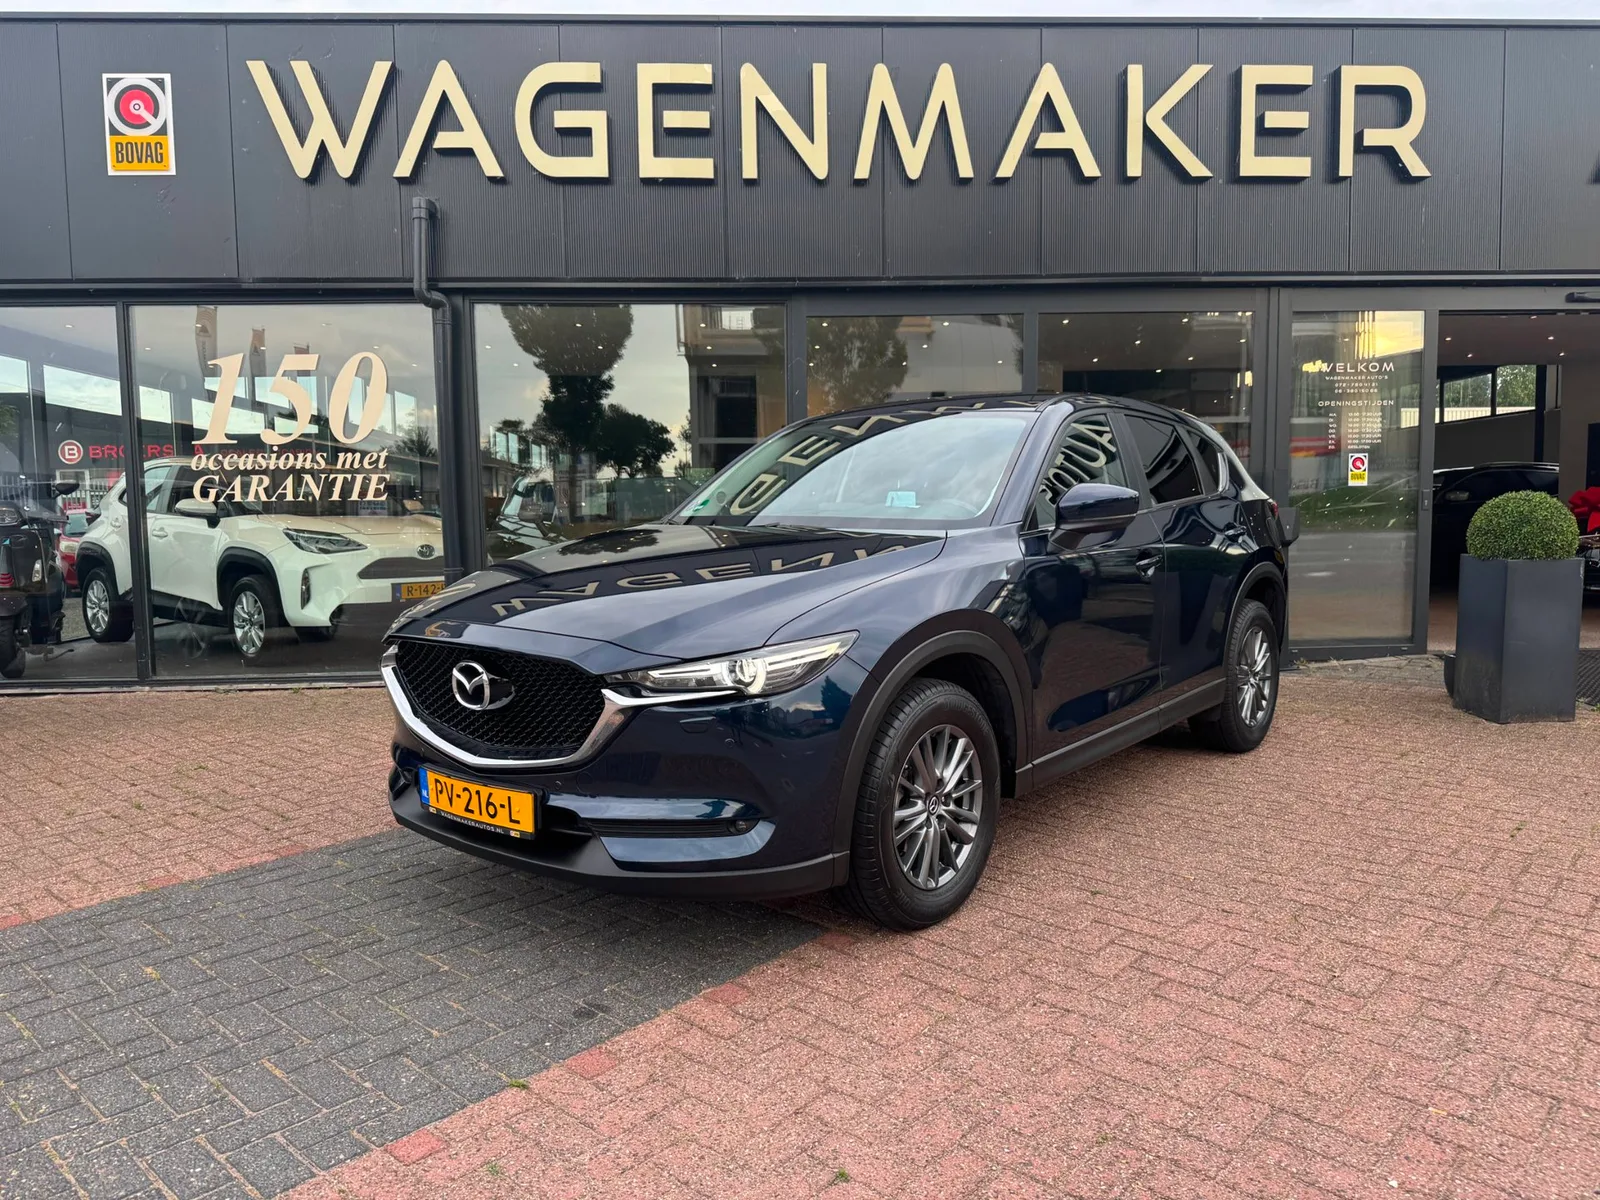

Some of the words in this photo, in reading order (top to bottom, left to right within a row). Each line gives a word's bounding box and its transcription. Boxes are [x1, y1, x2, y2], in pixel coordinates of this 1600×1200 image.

[246, 59, 1431, 182] WAGENMAKER
[115, 141, 164, 164] BOVAG
[191, 351, 389, 446] 150
[88, 445, 174, 459] BRRS
[190, 445, 327, 471] occasions
[336, 446, 388, 470] met
[192, 473, 391, 504] GARANTIE
[434, 777, 521, 825] PV-216-L
[441, 811, 505, 834] WAGENMAKERAUTOS.NL
